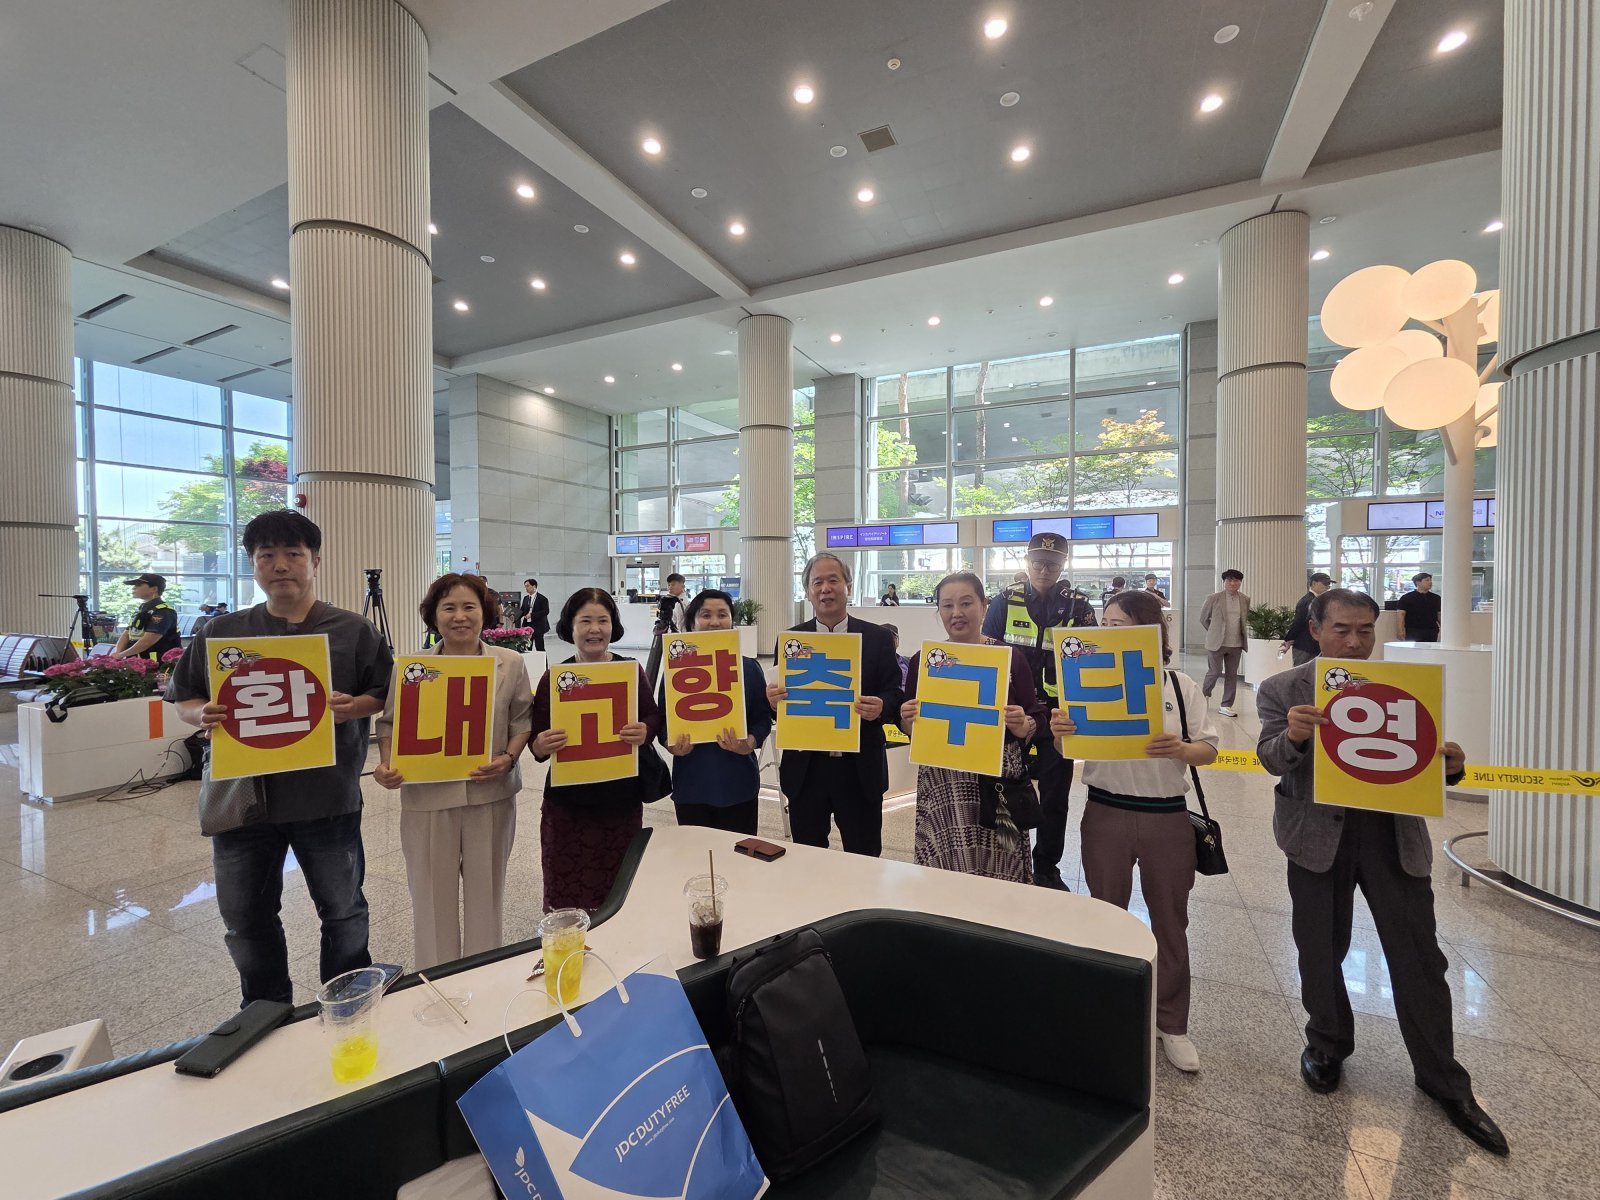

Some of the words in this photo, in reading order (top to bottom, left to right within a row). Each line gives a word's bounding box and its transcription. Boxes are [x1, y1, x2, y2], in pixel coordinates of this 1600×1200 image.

[230, 669, 316, 739] 환
[397, 675, 489, 757] 내
[556, 681, 634, 763] 고
[668, 649, 738, 722] 향
[785, 651, 856, 730] 축
[919, 663, 1000, 746] 구
[1061, 650, 1156, 737] 단
[1330, 695, 1418, 772] 영
[514, 1168, 537, 1194] JDC
[614, 1131, 639, 1163] JDC
